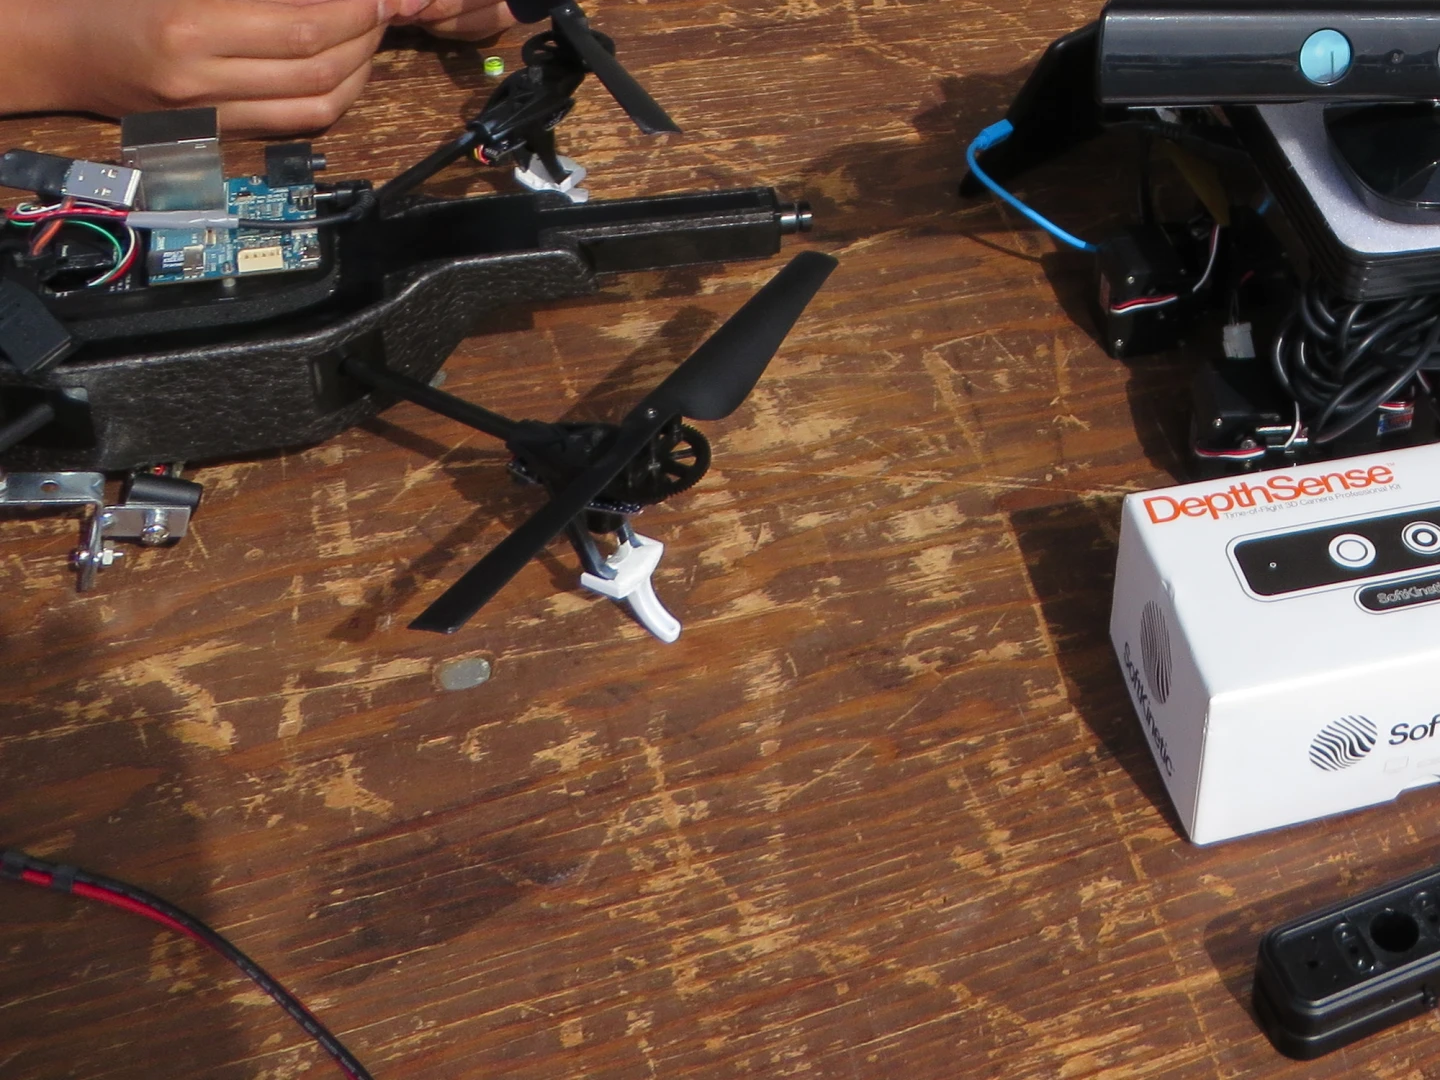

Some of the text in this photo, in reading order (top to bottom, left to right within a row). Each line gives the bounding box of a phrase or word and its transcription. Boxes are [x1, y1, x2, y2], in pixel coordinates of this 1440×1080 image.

[1143, 464, 1394, 524] DepthSense
[1300, 495, 1334, 508] Camera
[1123, 641, 1173, 778] SoftKinetic
